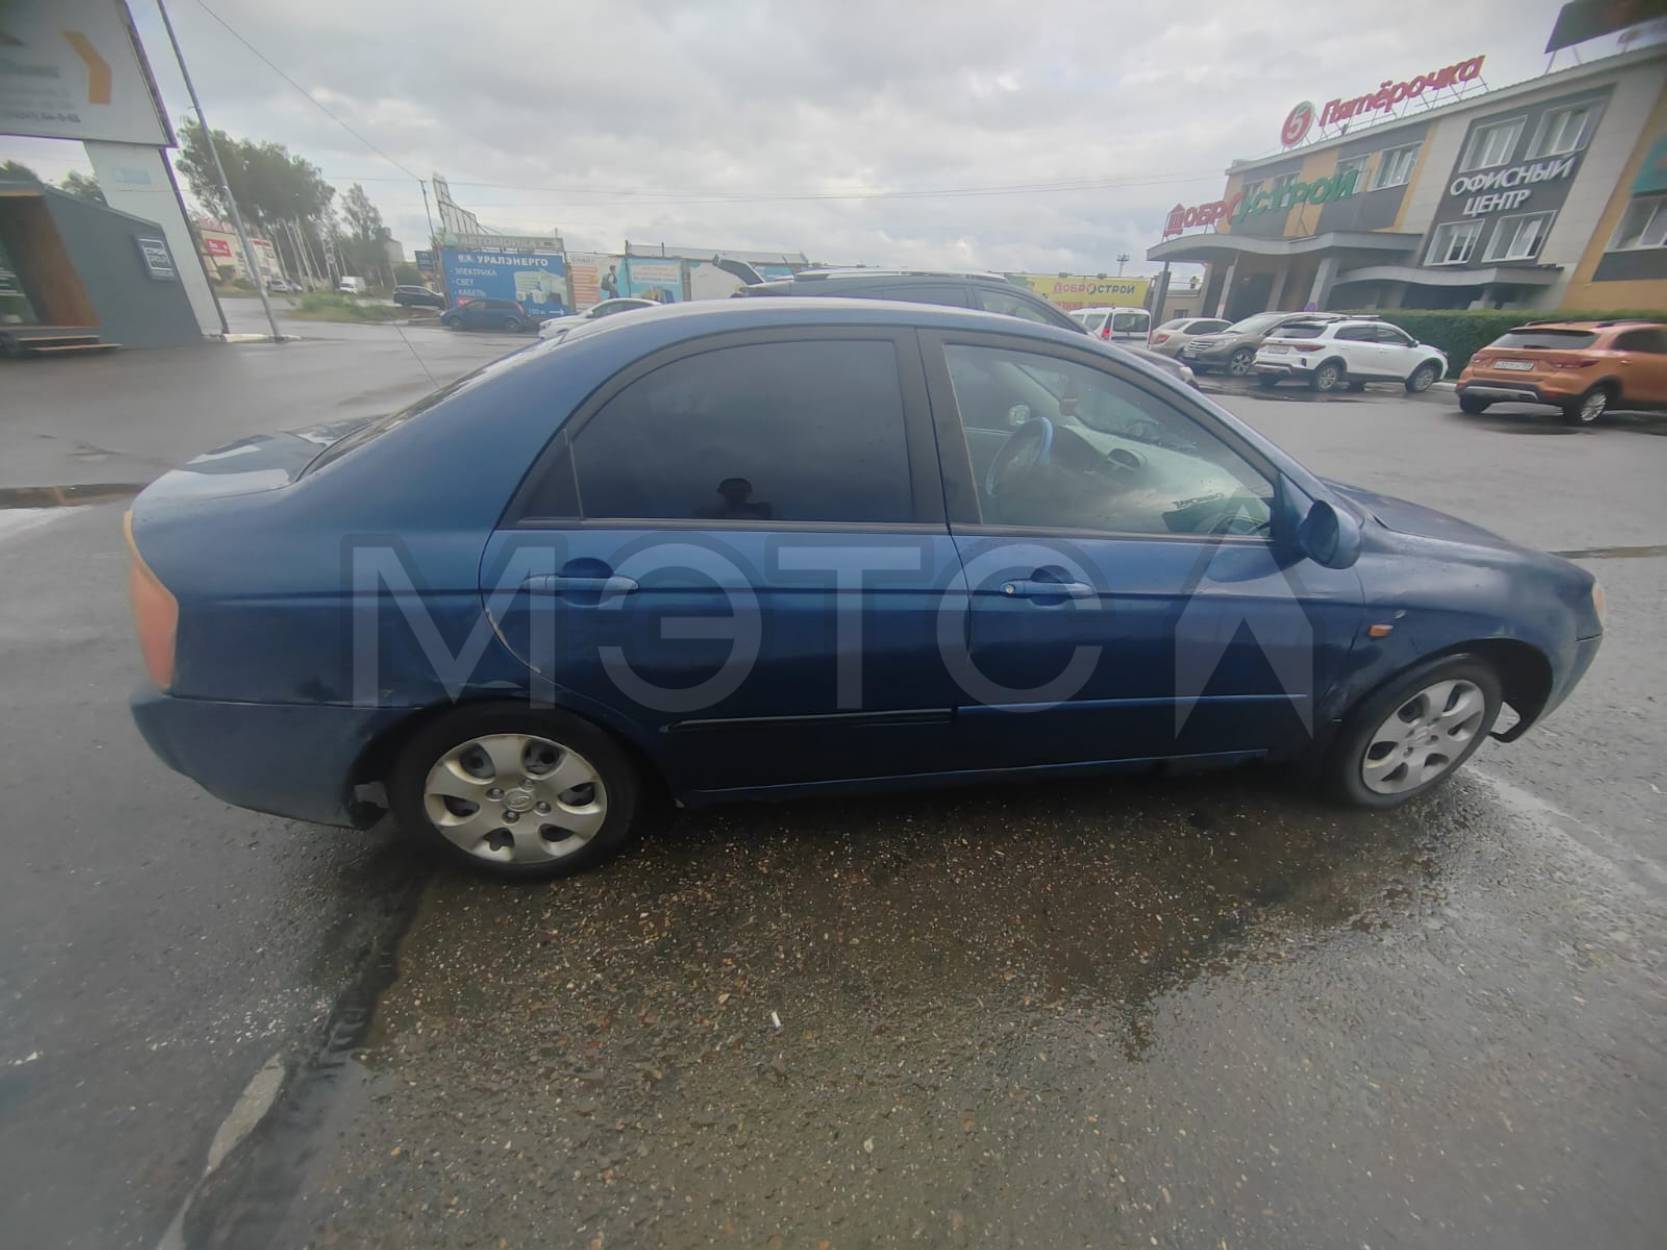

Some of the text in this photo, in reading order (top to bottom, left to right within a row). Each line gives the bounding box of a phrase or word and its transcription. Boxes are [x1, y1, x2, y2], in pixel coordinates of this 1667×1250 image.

[1318, 55, 1486, 128] Пятёрочка
[1450, 155, 1576, 196] ОФИСНЫЙ
[1462, 189, 1532, 217] ЦЕНТР
[478, 254, 549, 267] УРАЛЭНЕРГО
